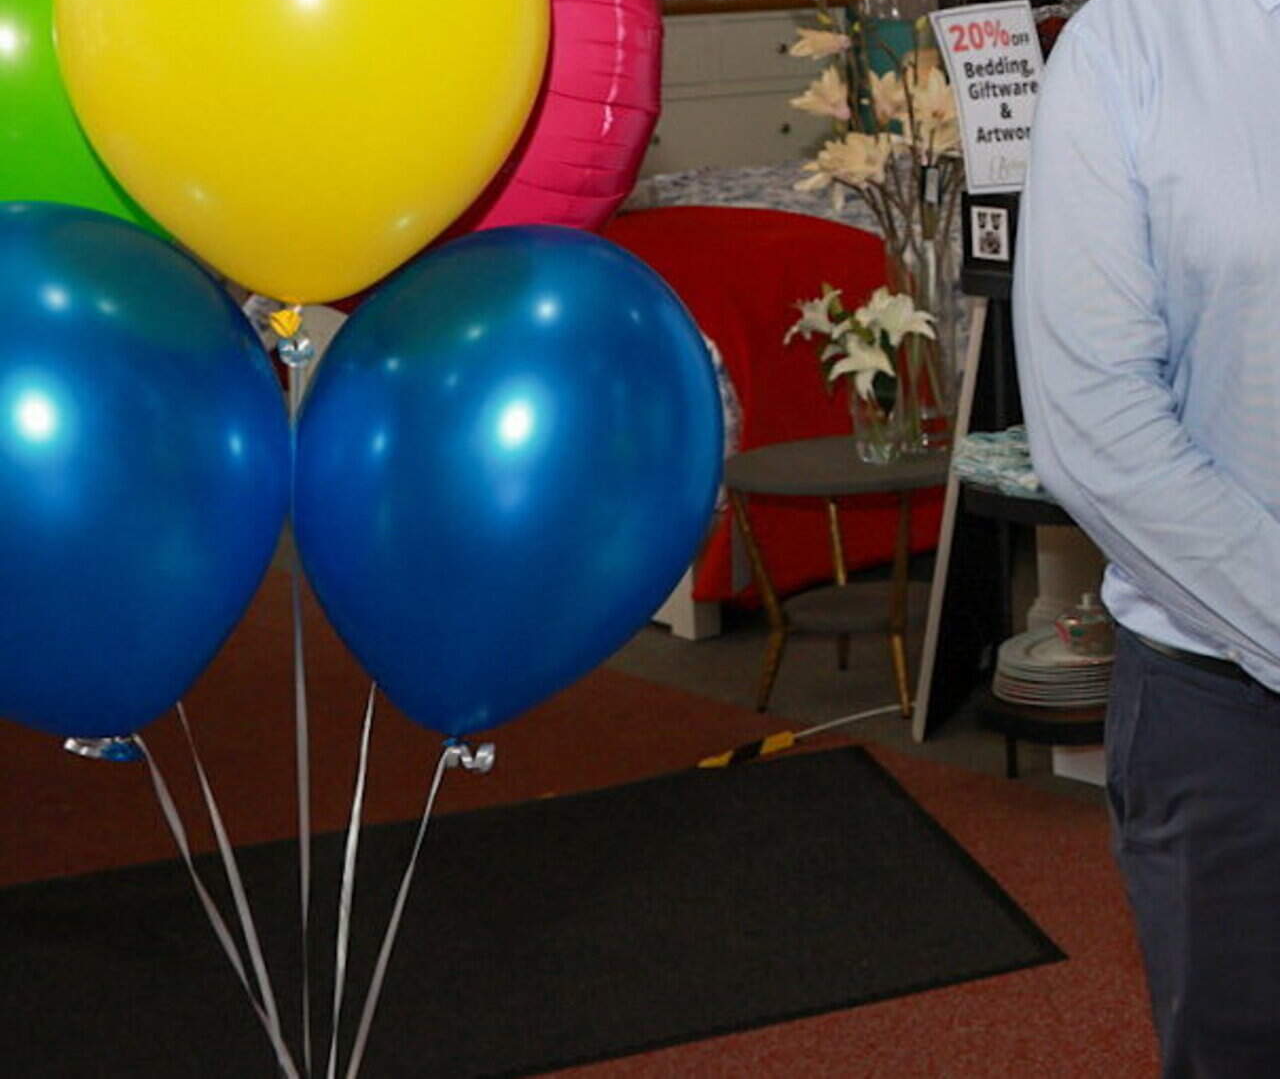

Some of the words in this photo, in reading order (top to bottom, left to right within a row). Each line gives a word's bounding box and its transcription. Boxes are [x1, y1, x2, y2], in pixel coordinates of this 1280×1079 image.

[949, 20, 1009, 52] 20%
[968, 81, 1038, 100] Giftware
[1000, 102, 1012, 119] &
[976, 126, 1031, 143] Artwor
